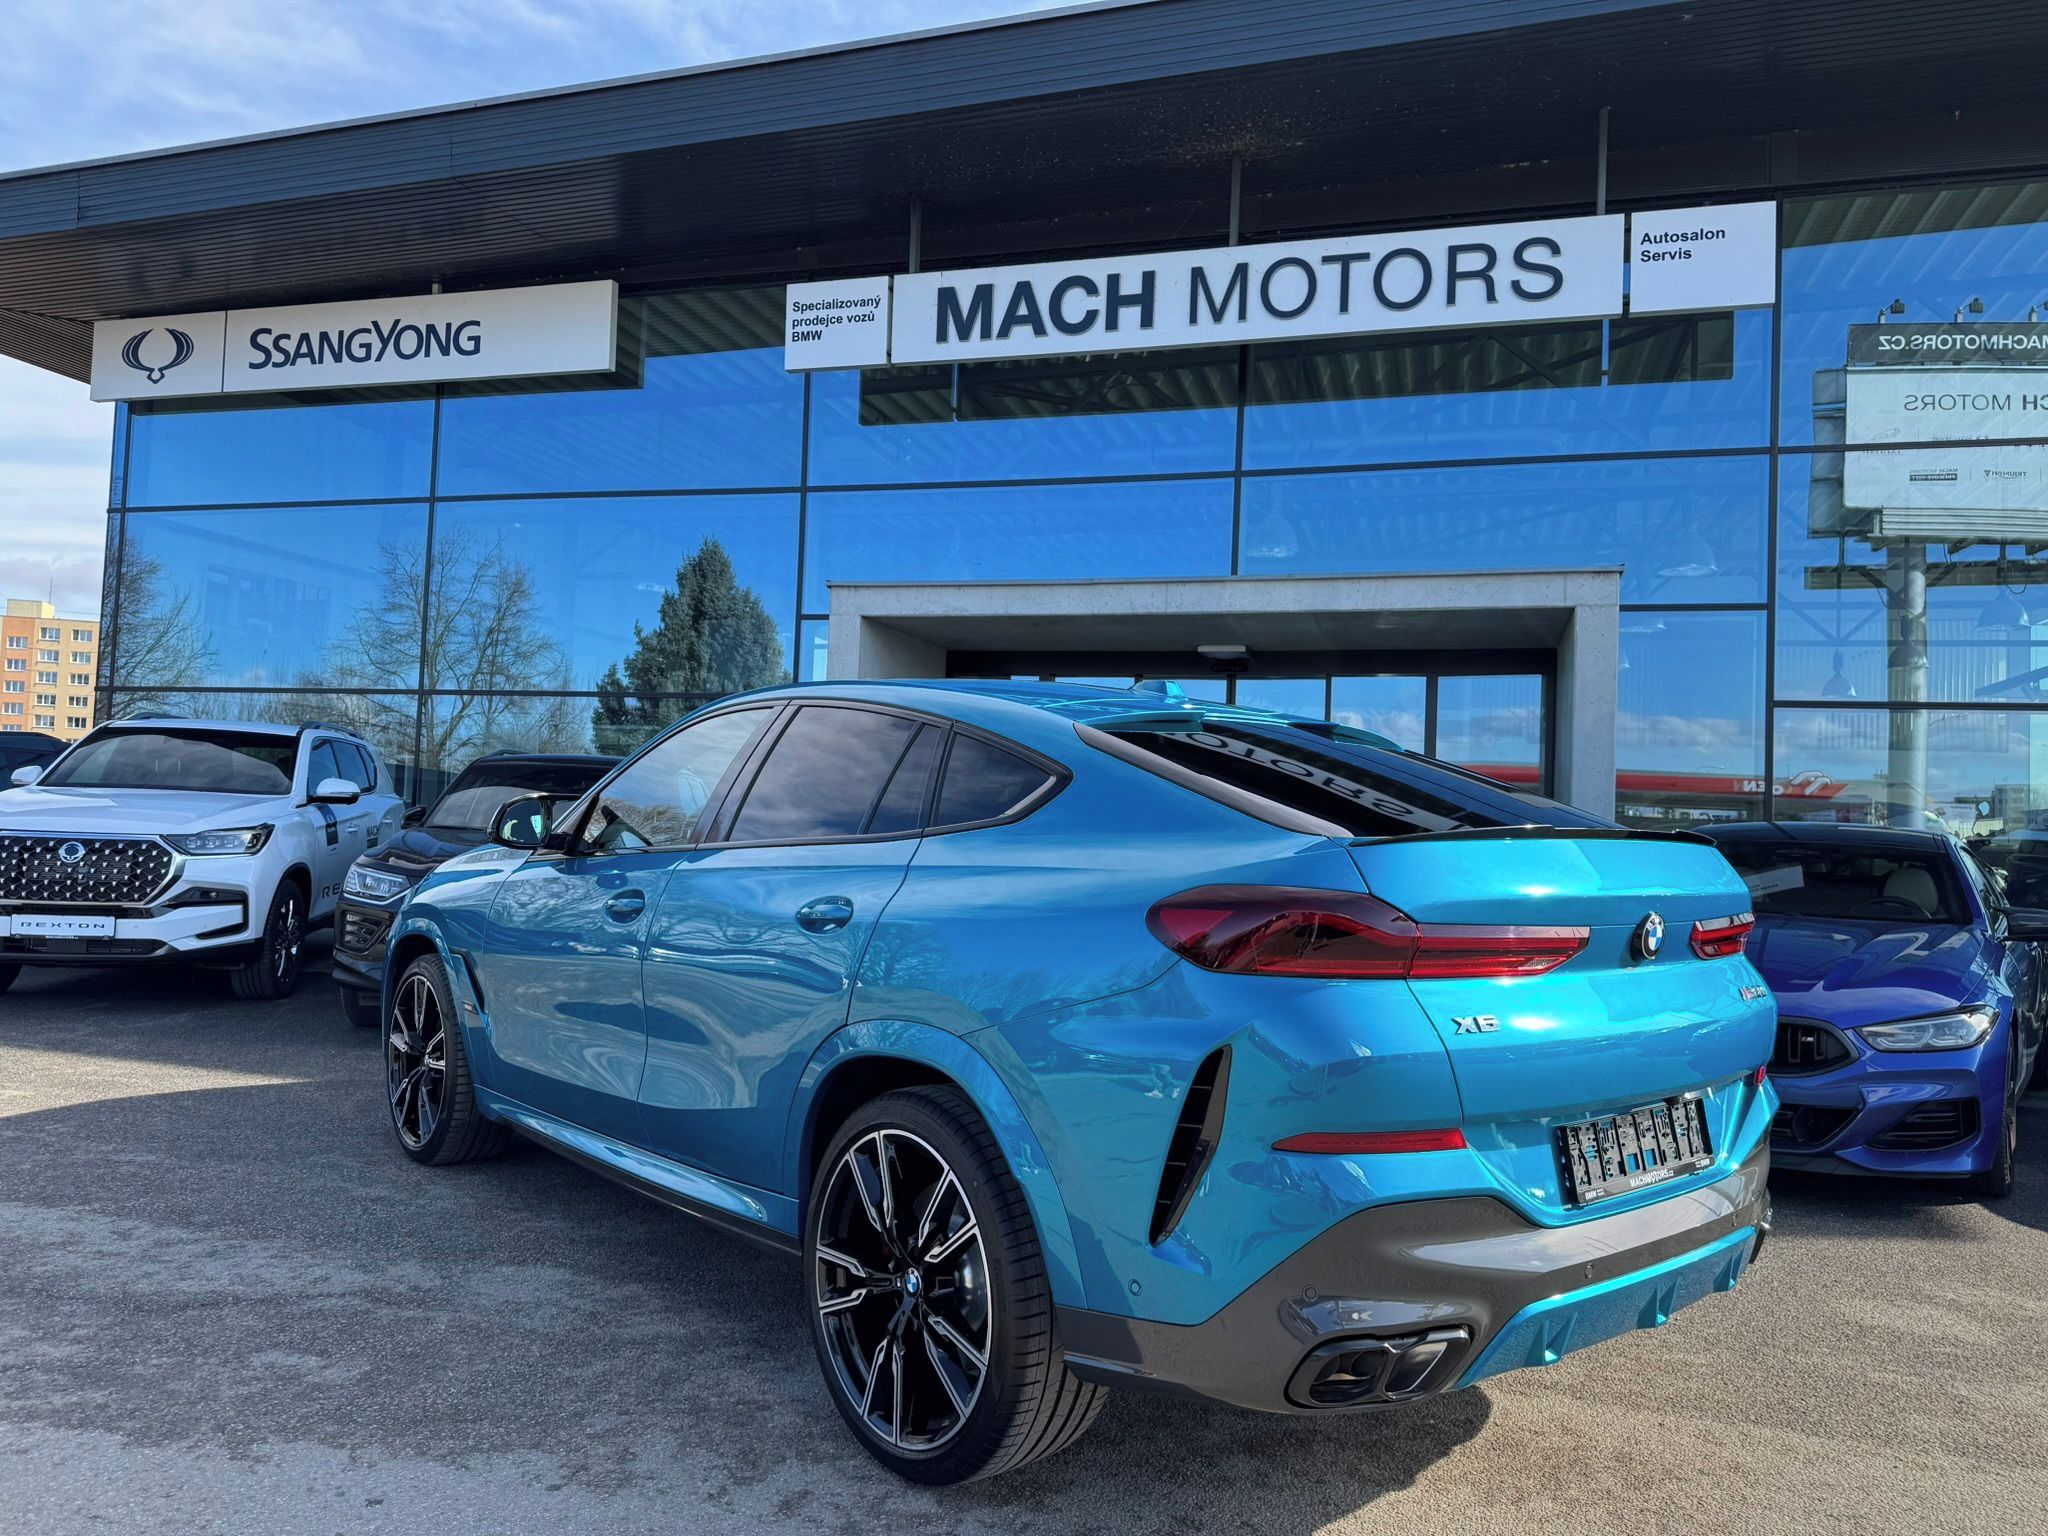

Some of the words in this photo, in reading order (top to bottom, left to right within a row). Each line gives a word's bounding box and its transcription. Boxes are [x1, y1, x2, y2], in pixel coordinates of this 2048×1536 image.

[1640, 228, 1726, 246] Autosalon
[1640, 247, 1692, 263] Servis
[936, 270, 1156, 344] MACH
[1189, 236, 1564, 325] MOTORS
[792, 294, 881, 314] Specializovaný
[792, 314, 843, 330] prodejce
[847, 310, 875, 323] vozů
[792, 329, 823, 343] BMW
[20, 921, 105, 929] REXTON
[1451, 1015, 1500, 1035] X6
